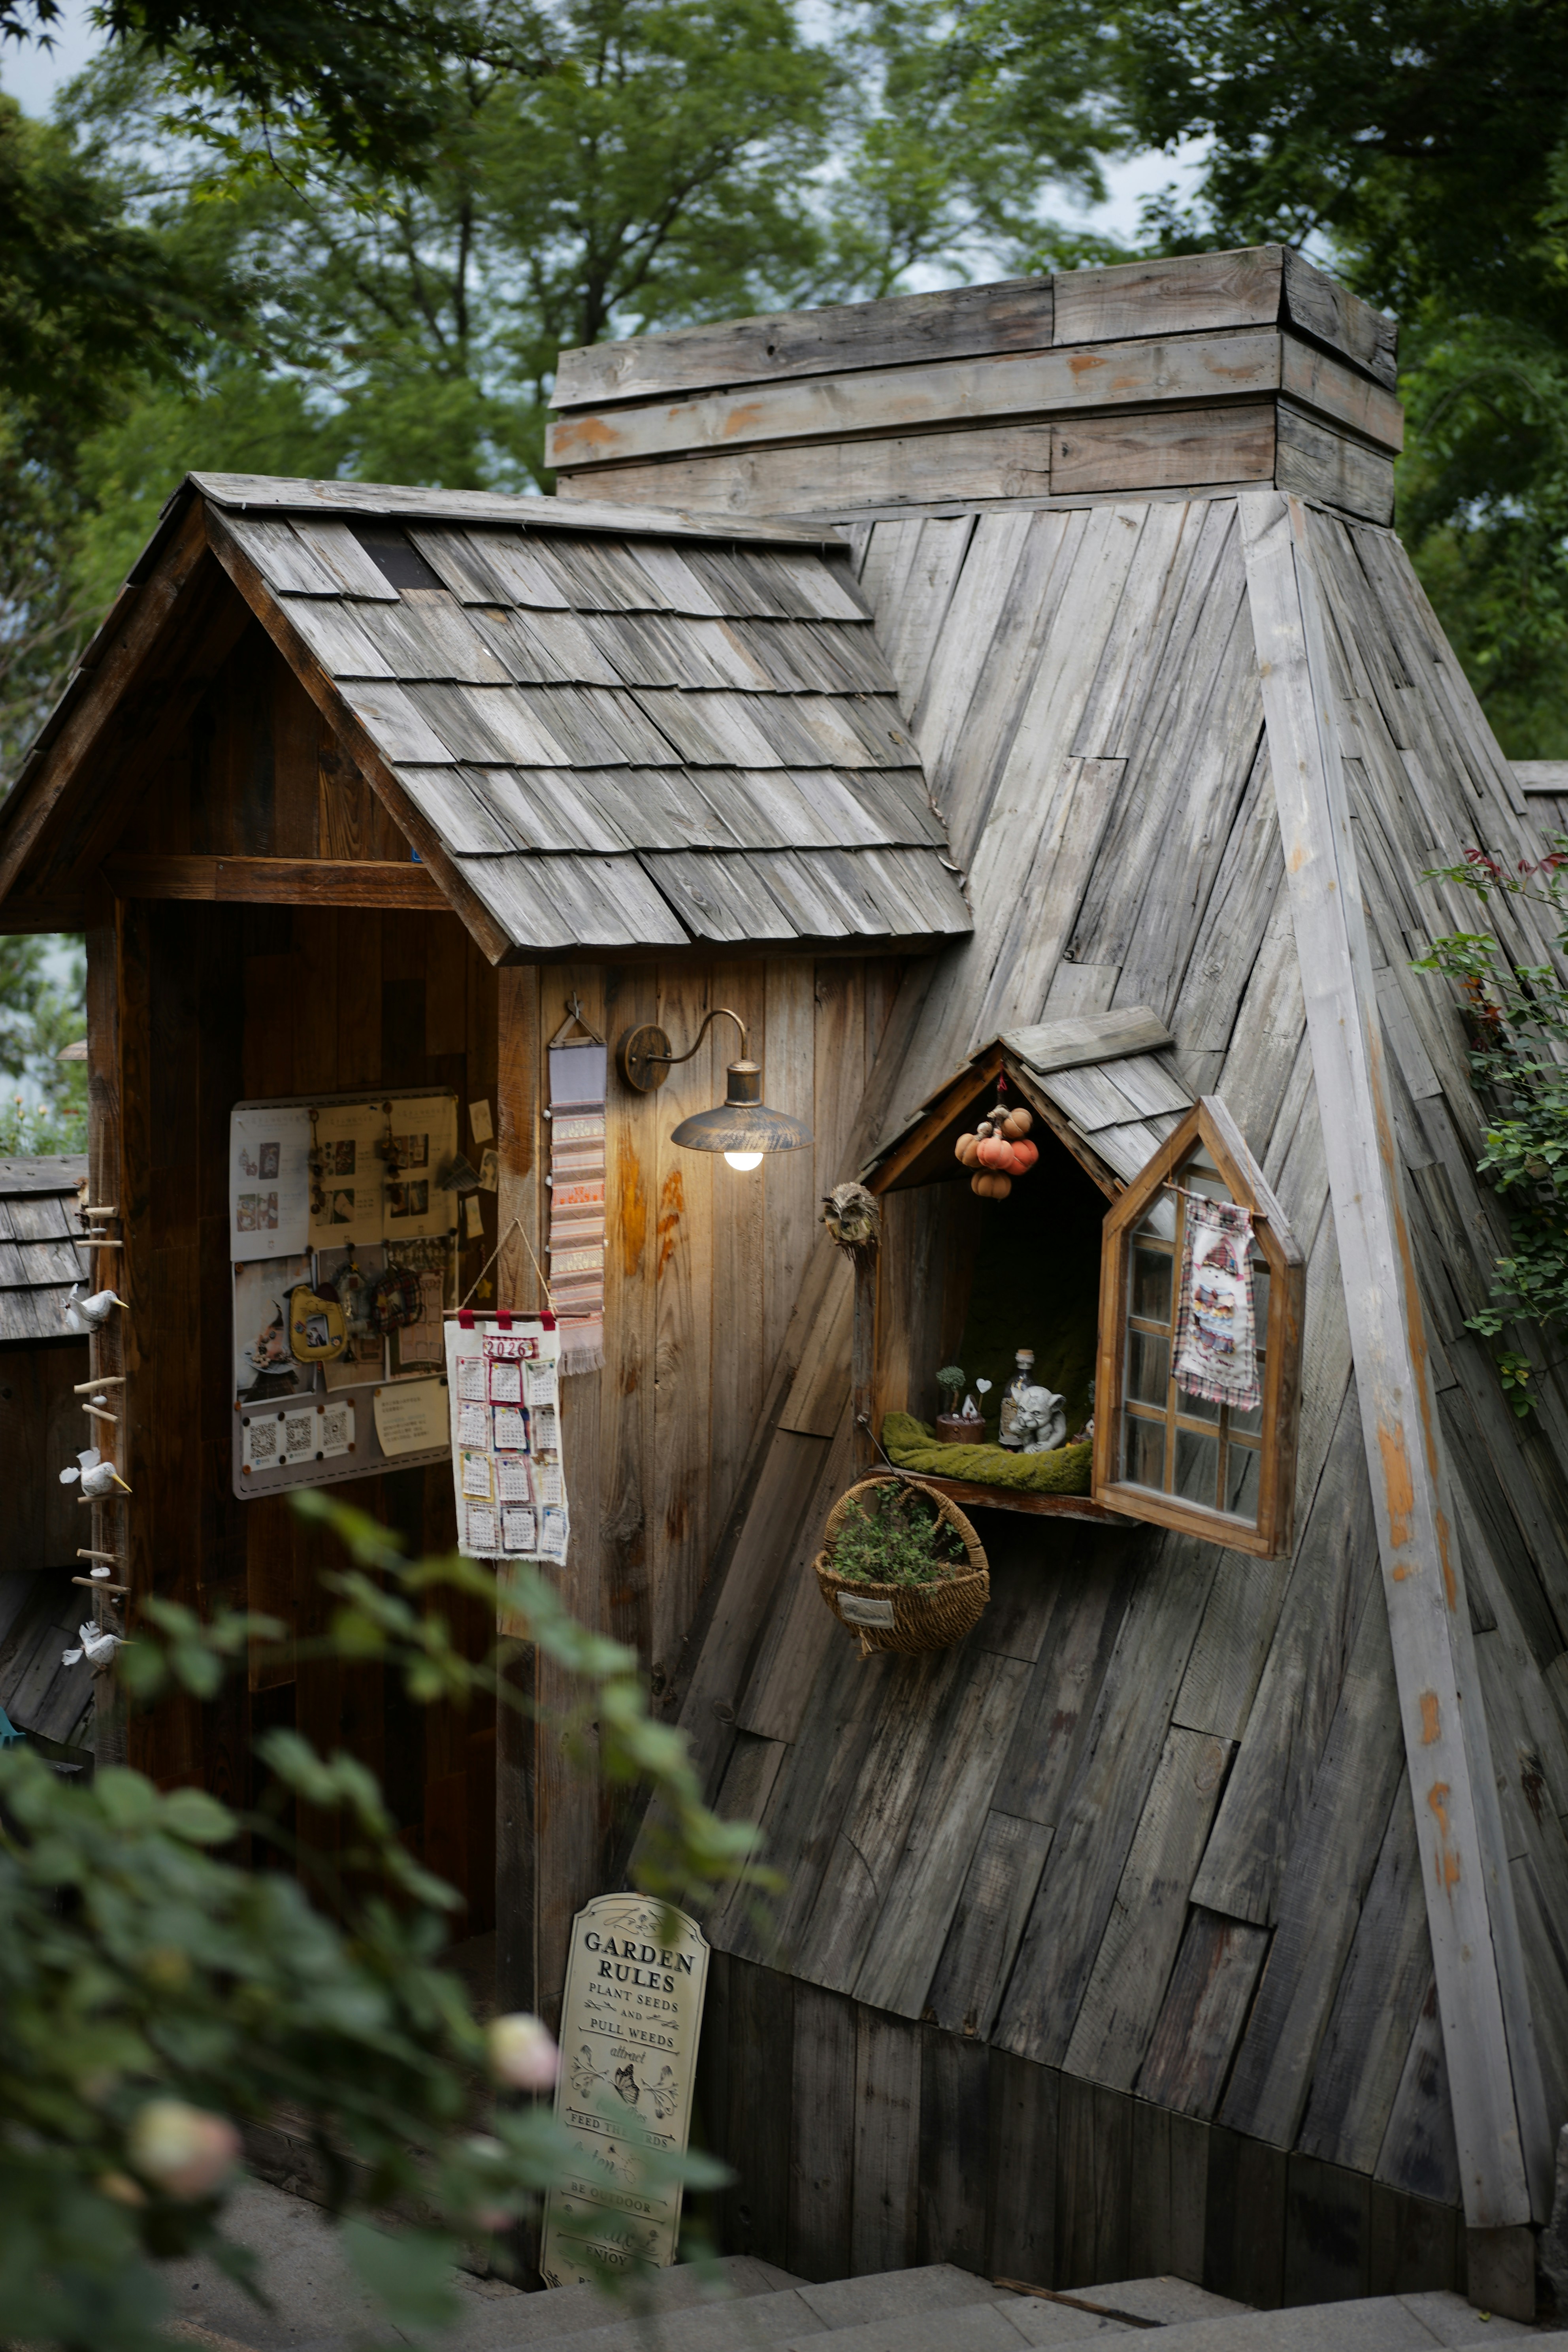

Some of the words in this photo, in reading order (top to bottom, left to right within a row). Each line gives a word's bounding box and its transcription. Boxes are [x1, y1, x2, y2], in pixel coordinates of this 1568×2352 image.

[488, 1341, 525, 1356] 2026
[584, 1932, 695, 1975] GARDEN
[598, 1959, 675, 1993] RULES
[588, 1982, 632, 2001] PLANT
[637, 1994, 678, 2012] SEEDS
[621, 2009, 642, 2020] AND
[590, 2018, 623, 2035] PULL
[629, 2027, 674, 2047] WEEDS
[610, 2045, 646, 2064] attract
[571, 2113, 600, 2128] FEED
[605, 2122, 627, 2137] THE
[571, 2181, 586, 2194] BE
[590, 2188, 651, 2213] OUTDOOR
[586, 2245, 628, 2266] ENJOY
